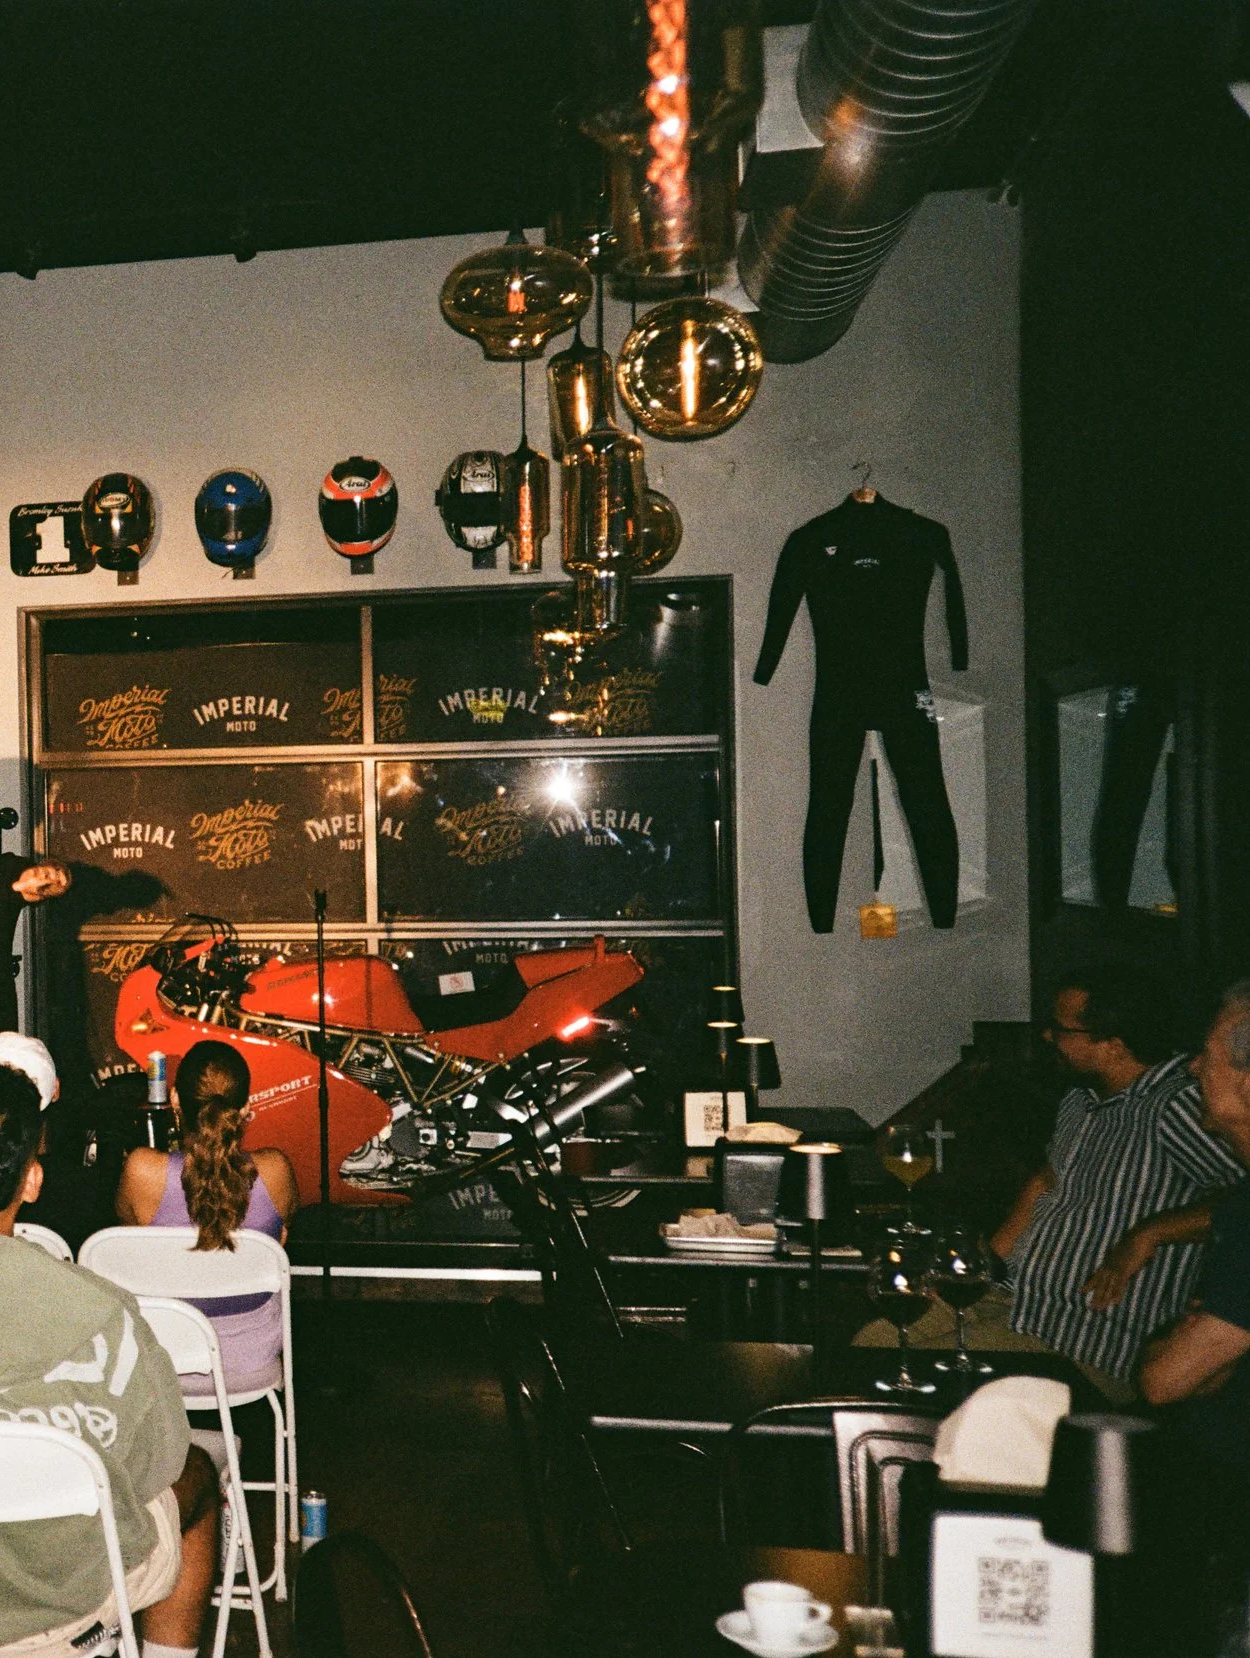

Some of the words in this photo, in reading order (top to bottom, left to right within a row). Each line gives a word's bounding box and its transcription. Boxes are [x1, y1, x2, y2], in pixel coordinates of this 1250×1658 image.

[36, 516, 70, 564] 1
[78, 684, 171, 724] Imperial
[193, 696, 290, 725] IMPERIAL
[438, 687, 538, 716] IMPERIAL
[226, 721, 256, 732] MOTO
[190, 799, 285, 839] Imperial
[305, 813, 405, 843] IMPEAL
[549, 809, 654, 839] IMPERIAL
[80, 822, 176, 851] IMPERIAL
[339, 839, 363, 851] MOT
[113, 847, 143, 859] MOTO
[216, 850, 272, 870] COFFEE
[476, 953, 508, 965] MOTO
[248, 1075, 312, 1103] RSPORT
[448, 1184, 500, 1210] IMPE
